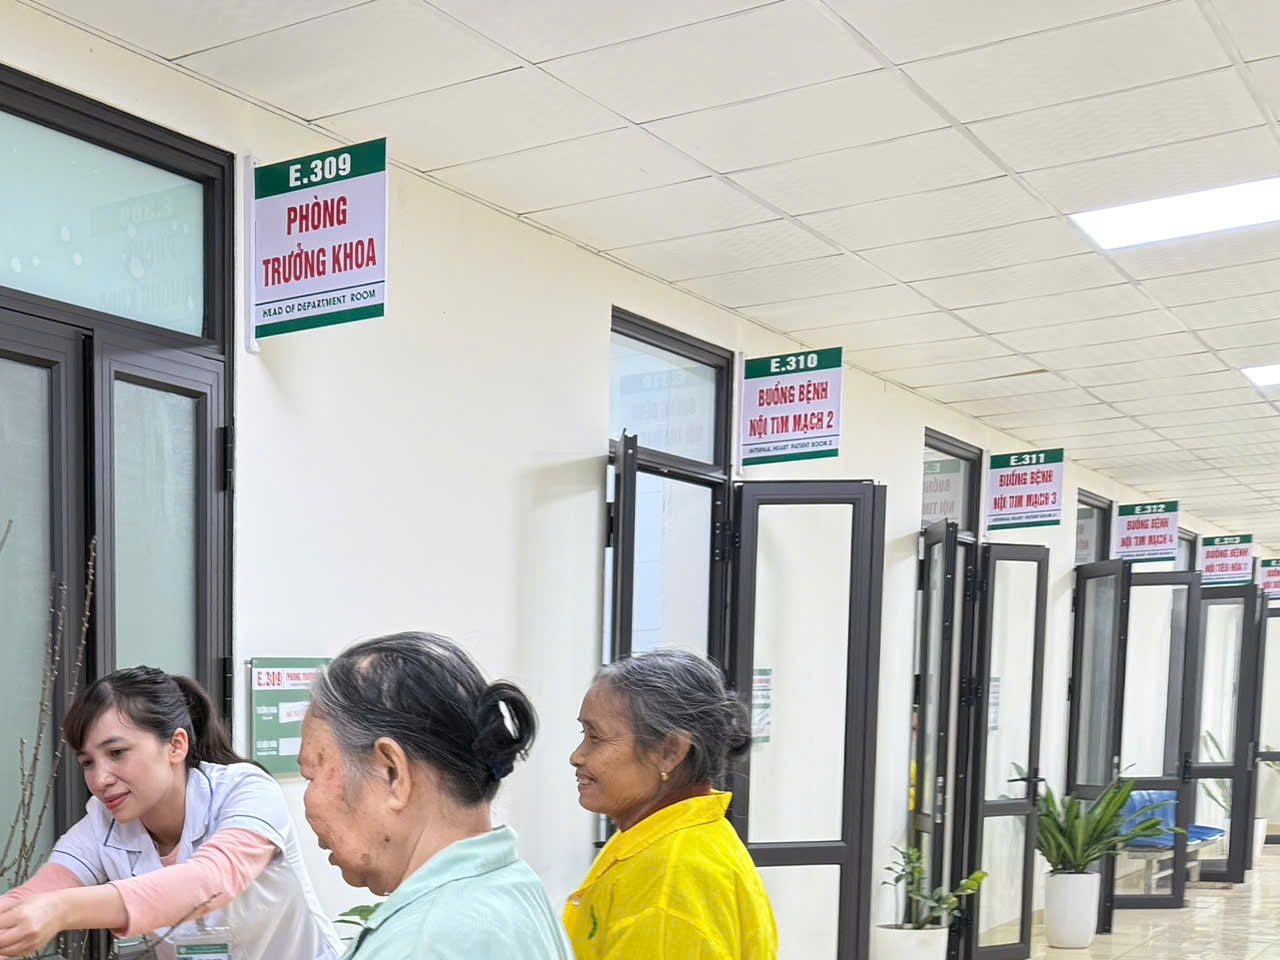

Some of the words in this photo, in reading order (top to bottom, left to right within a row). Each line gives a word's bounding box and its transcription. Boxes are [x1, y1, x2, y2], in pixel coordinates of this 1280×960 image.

[289, 153, 351, 187] E.309
[287, 195, 348, 235] PHÒNG
[262, 243, 326, 287] TRƯỞNG
[332, 238, 377, 274] KHOA
[262, 306, 283, 318] HEAD
[285, 303, 295, 314] OF
[297, 295, 346, 312] DEPARTMENT
[350, 290, 376, 302] ROOM
[770, 354, 818, 373] E.310
[798, 380, 828, 404] BỆNH
[749, 415, 768, 438] NỘI
[771, 415, 789, 435] TIM
[792, 411, 824, 434] MẠCH
[826, 410, 834, 429] 2
[1010, 453, 1046, 466] E.311
[1051, 491, 1057, 505] 3
[1134, 504, 1166, 514] E.312
